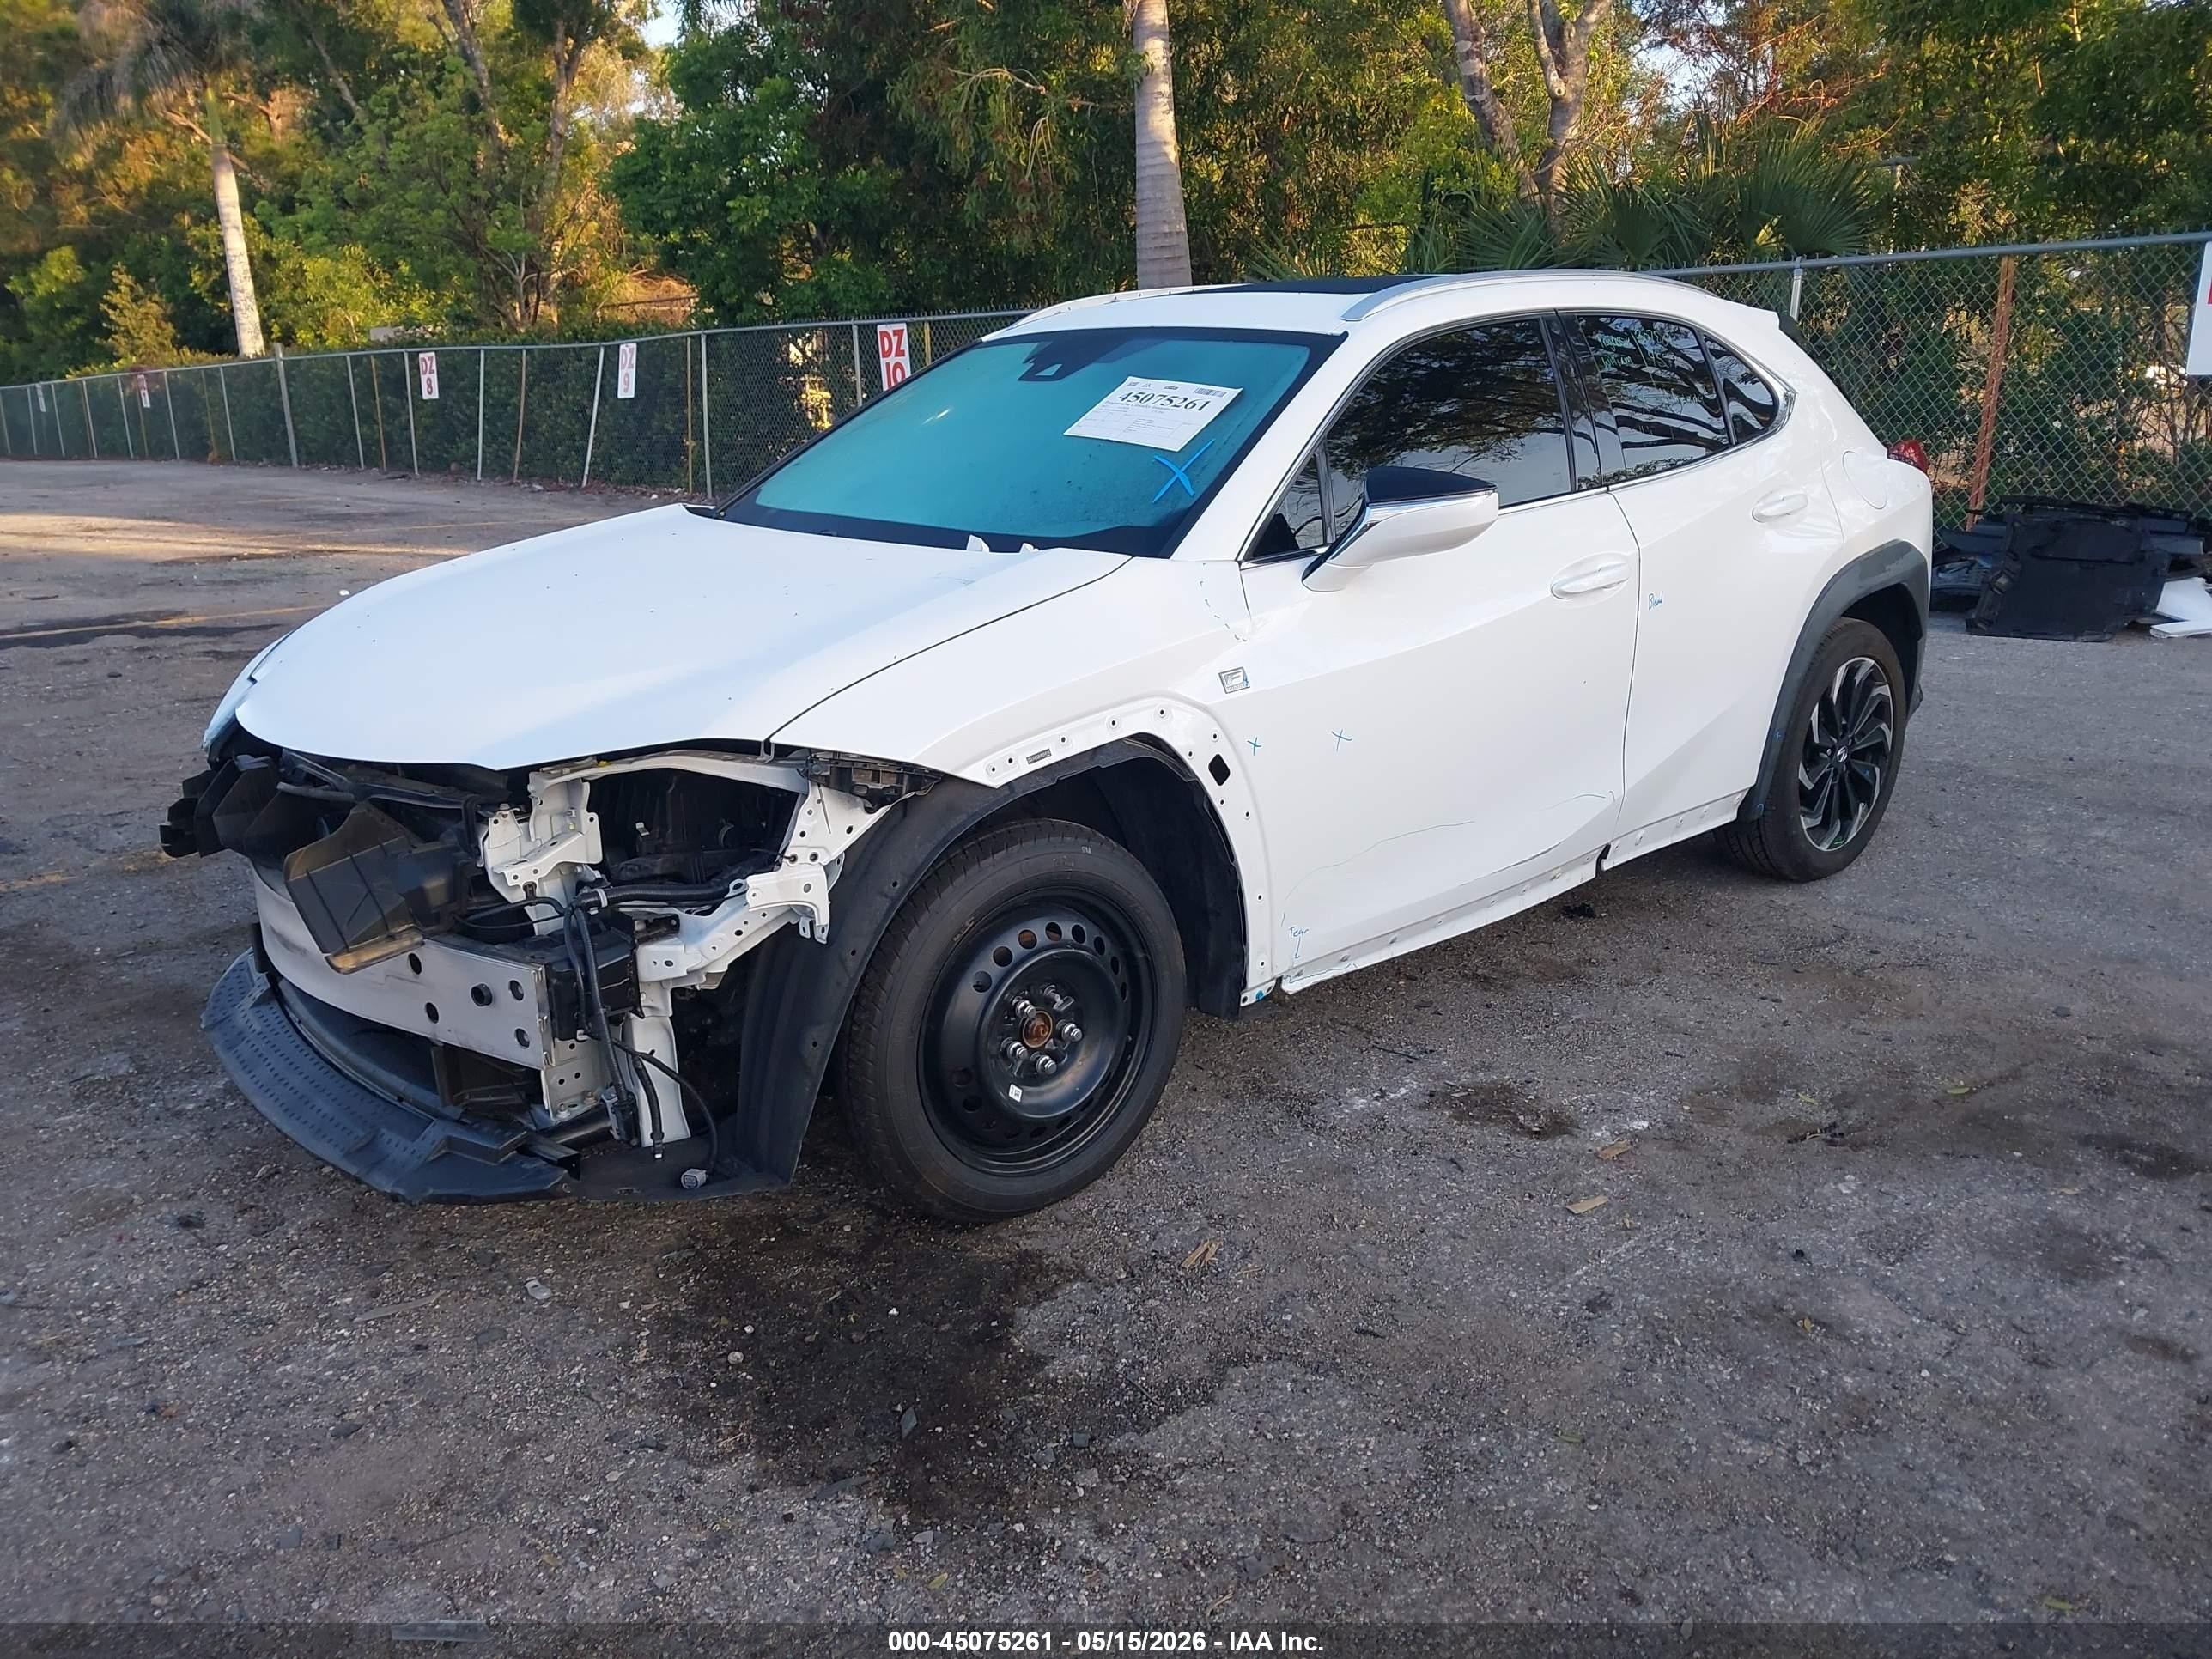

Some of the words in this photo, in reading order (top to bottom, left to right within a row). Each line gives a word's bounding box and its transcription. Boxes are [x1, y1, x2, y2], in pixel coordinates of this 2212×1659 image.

[879, 329, 905, 358] DZ
[421, 356, 434, 375] DZ
[621, 348, 635, 369] DZ
[426, 377, 434, 395] 8
[623, 372, 630, 393] 9
[1118, 391, 1212, 411] 45075261
